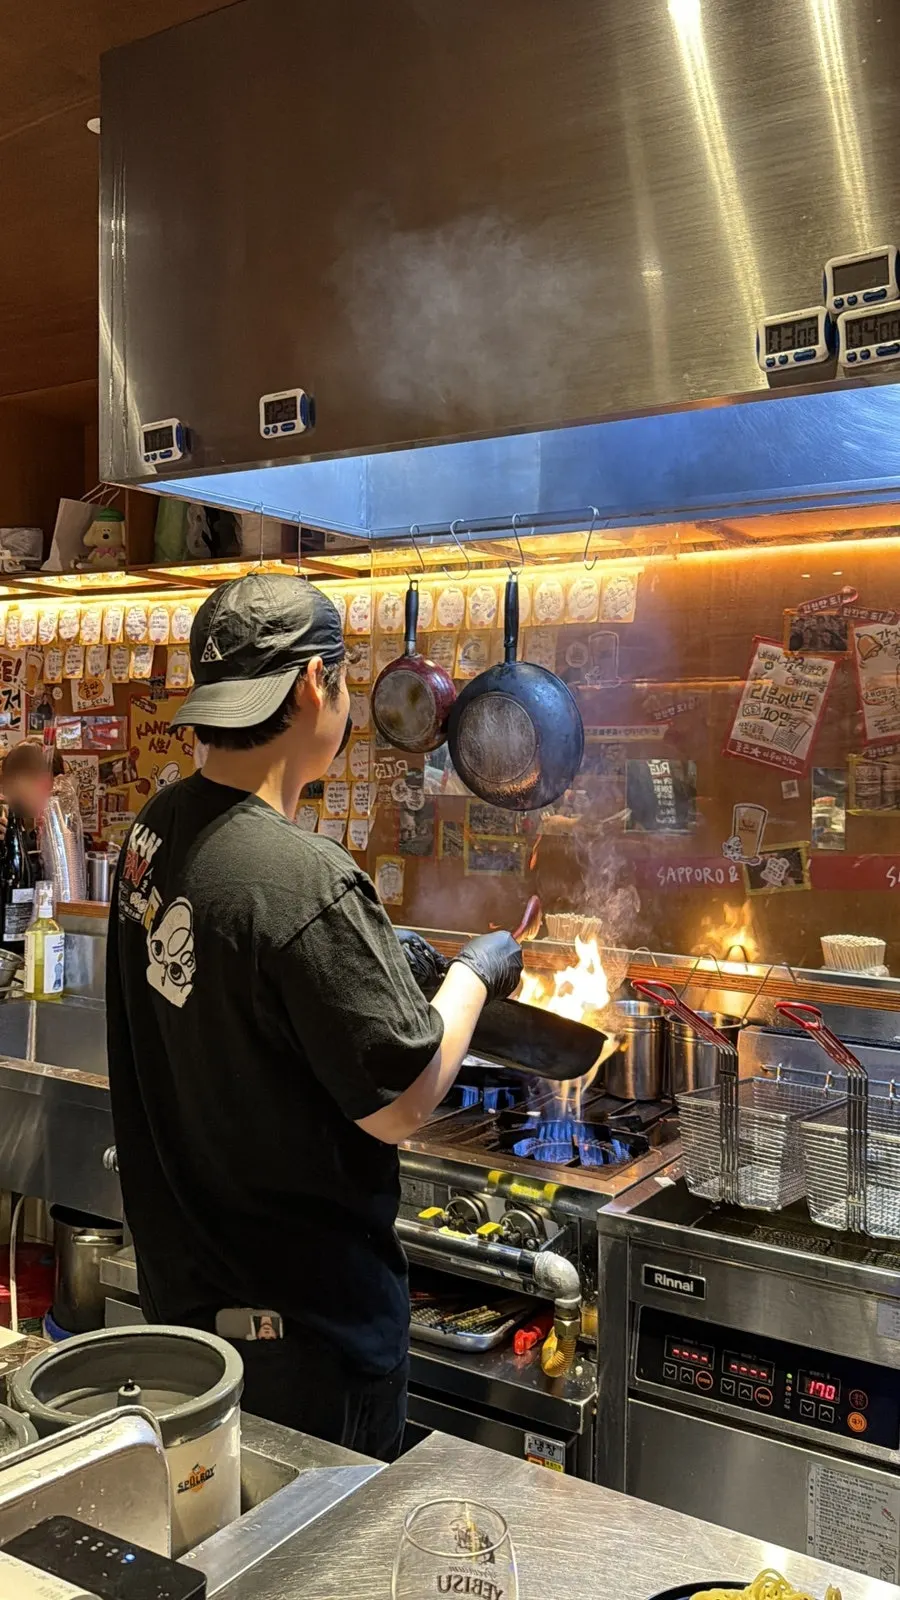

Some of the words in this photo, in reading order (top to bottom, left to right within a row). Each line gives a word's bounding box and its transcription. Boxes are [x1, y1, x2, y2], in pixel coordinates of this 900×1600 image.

[0, 657, 22, 682] E!
[135, 720, 187, 742] KANPI
[655, 866, 724, 886] SAPPORO
[885, 866, 900, 888] S
[653, 1272, 694, 1293] Rinnai
[808, 1380, 836, 1401] 170
